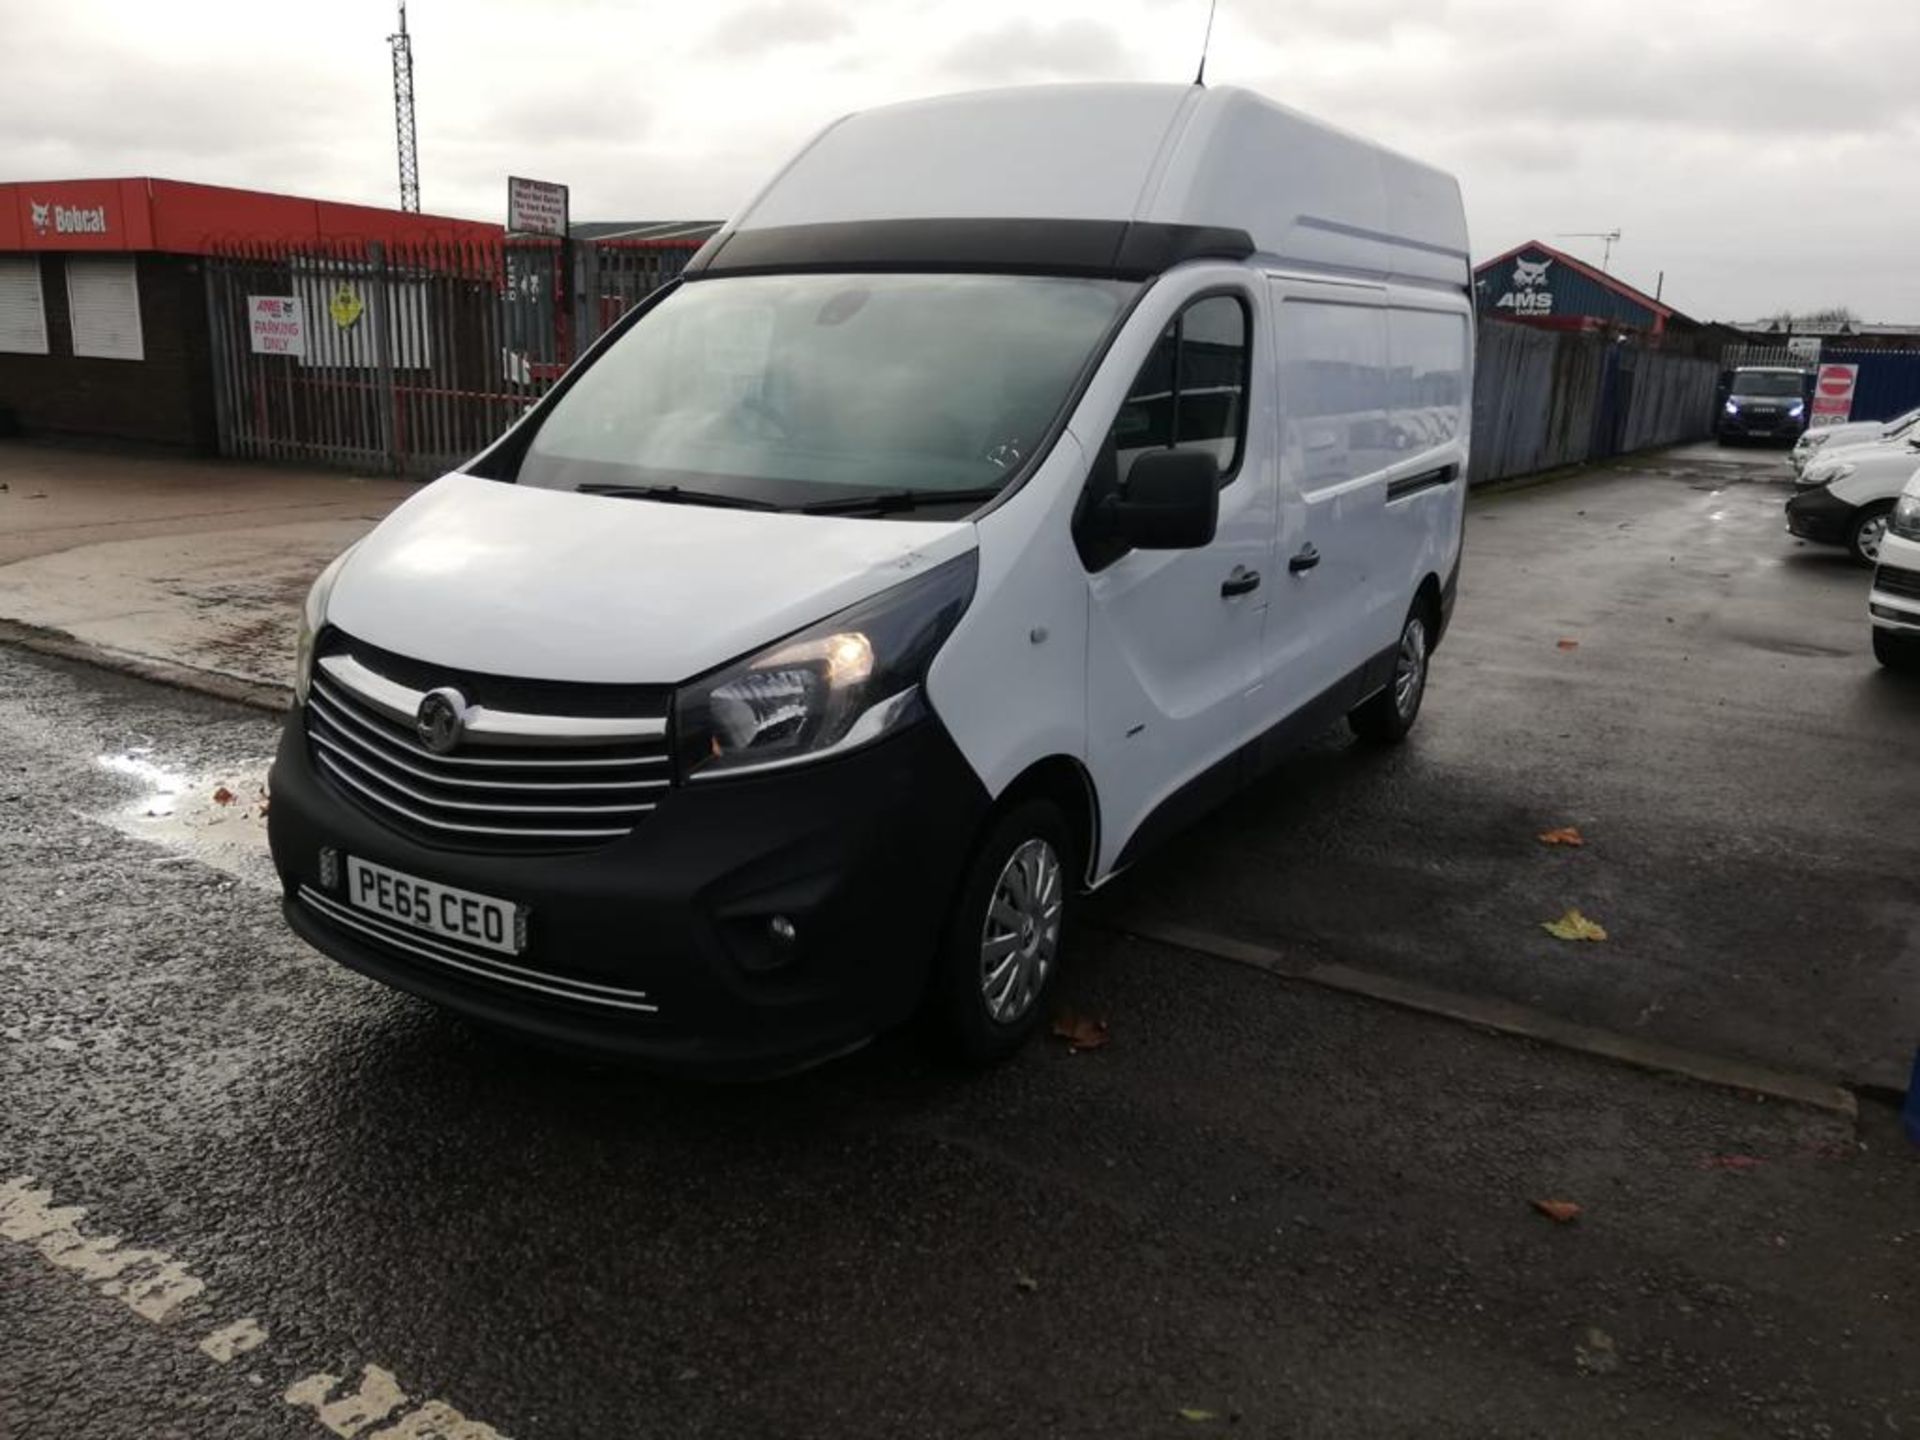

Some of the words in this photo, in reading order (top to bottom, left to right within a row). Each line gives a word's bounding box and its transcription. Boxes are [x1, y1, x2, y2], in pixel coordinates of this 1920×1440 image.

[55, 205, 106, 232] Bobcat
[1496, 292, 1554, 307] AMS
[254, 320, 299, 336] PARKING
[263, 337, 290, 351] ONLY
[358, 865, 432, 924] PE65
[441, 894, 504, 944] CEO
